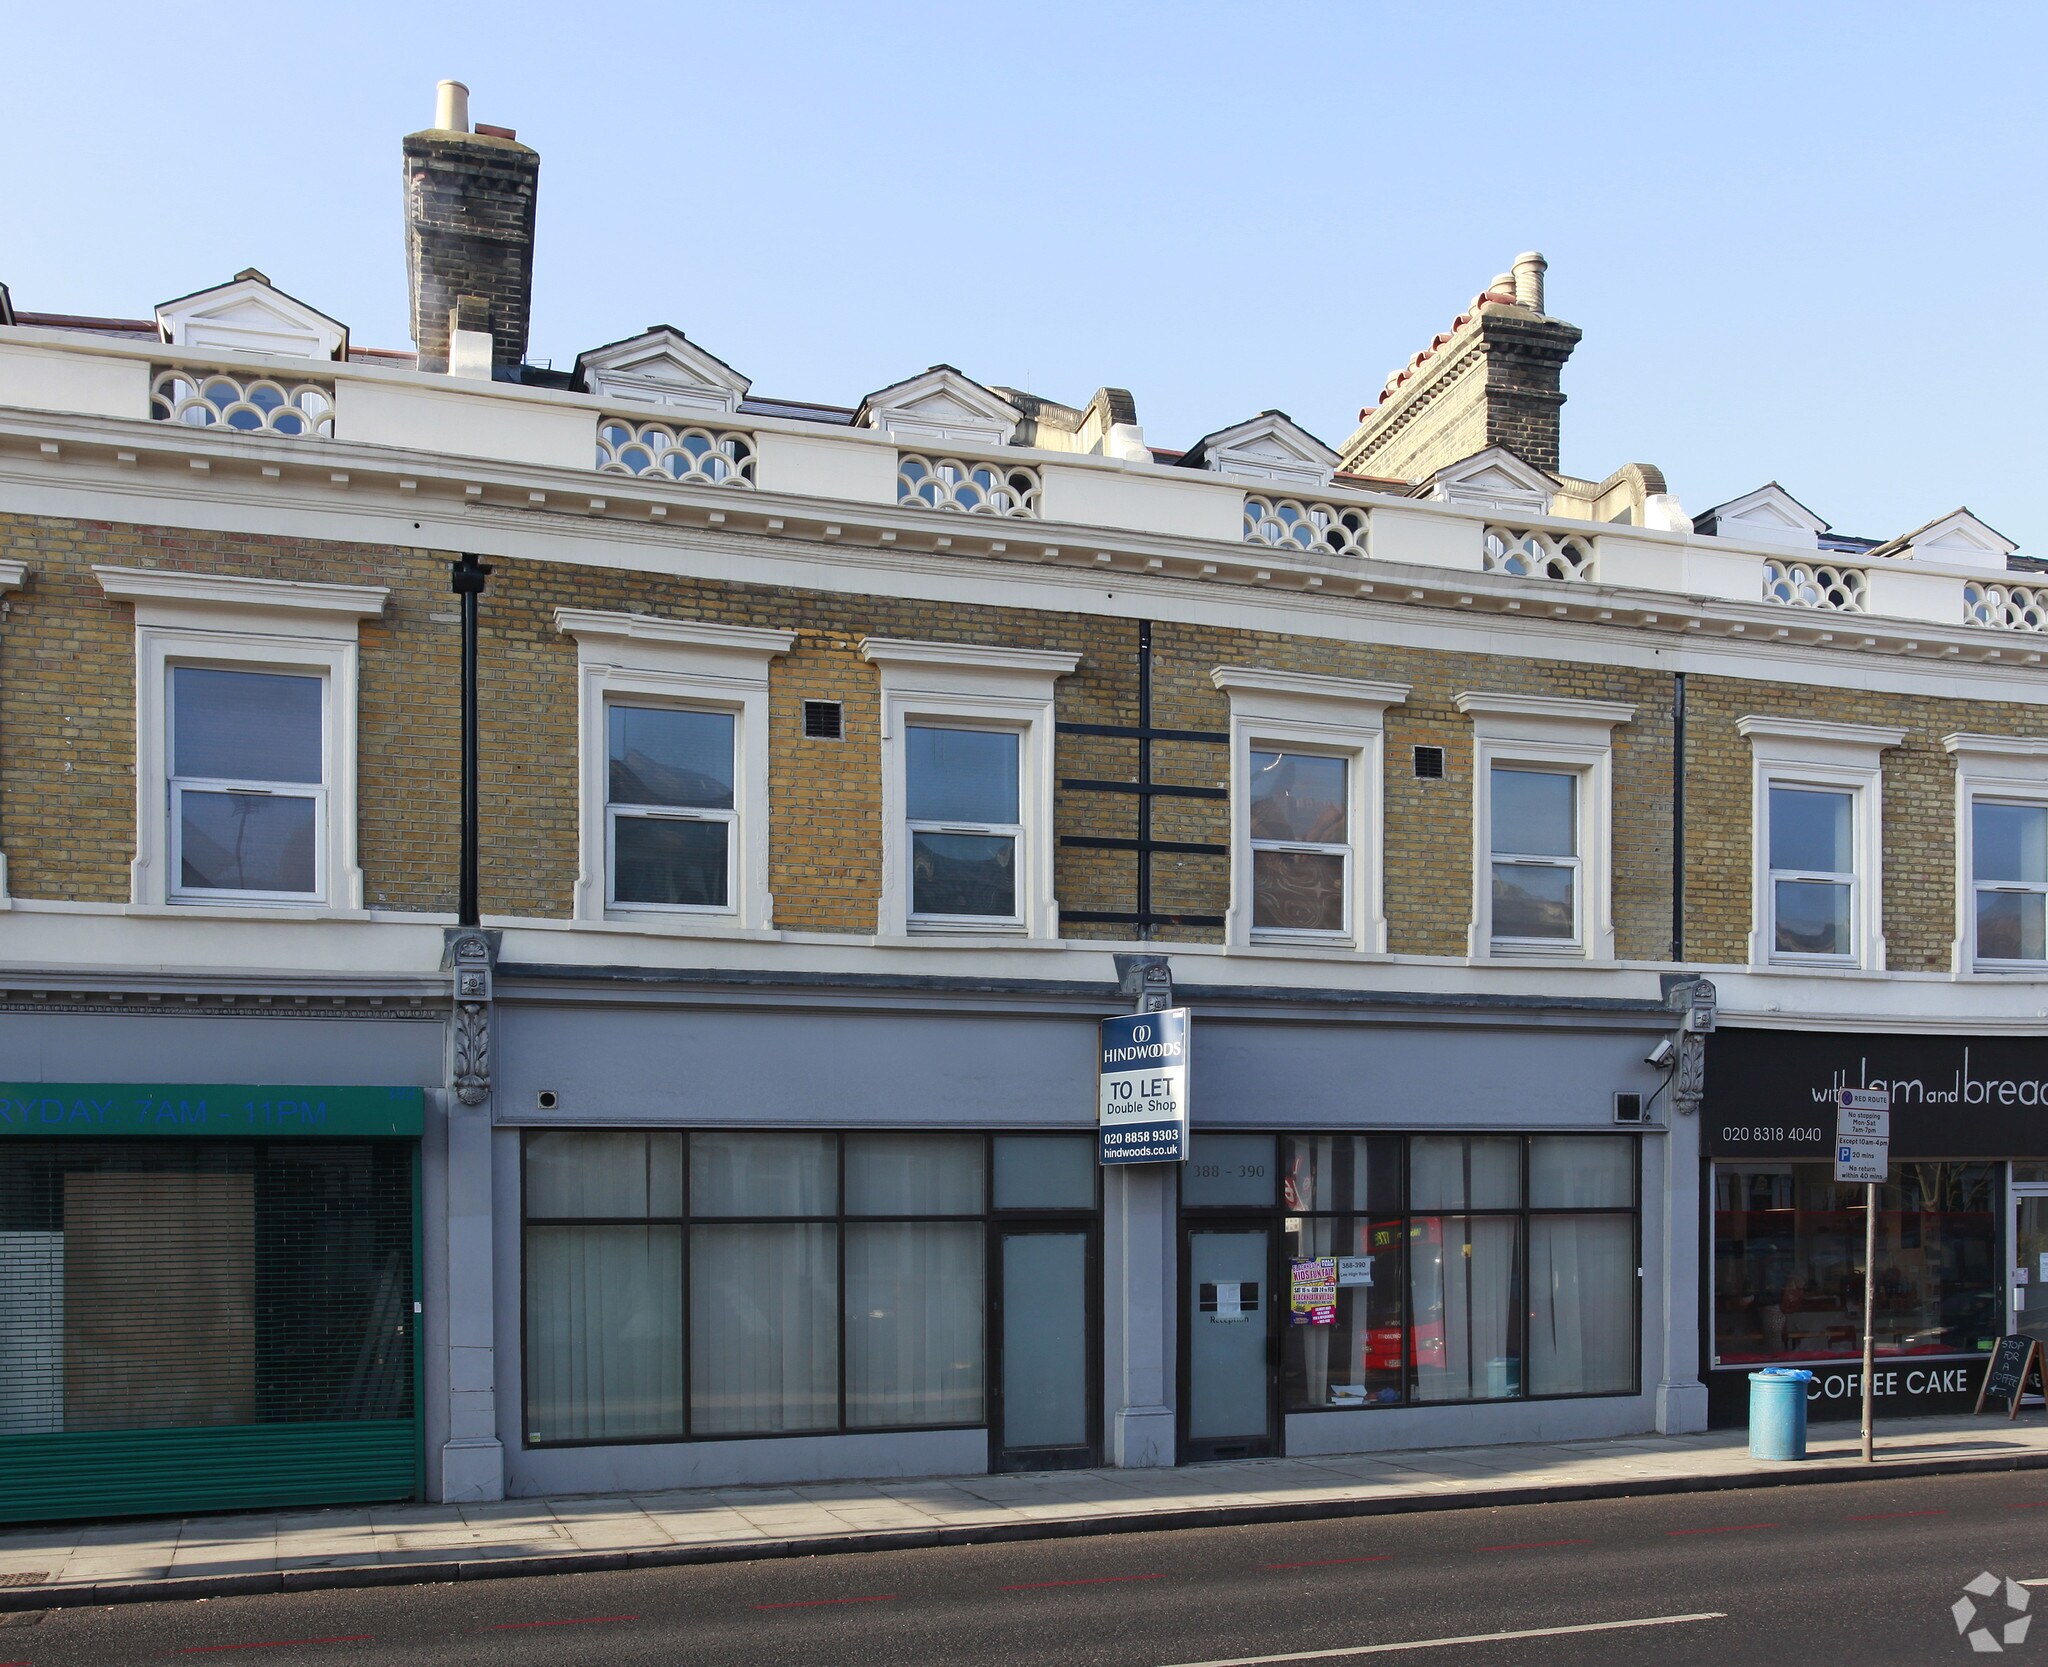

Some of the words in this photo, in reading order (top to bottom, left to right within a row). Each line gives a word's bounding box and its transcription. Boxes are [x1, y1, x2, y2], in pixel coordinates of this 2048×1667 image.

[1104, 1041, 1181, 1063] HINDWOODS
[1110, 1080, 1133, 1100] TO
[1141, 1078, 1174, 1098] LET
[1926, 1069, 1959, 1104] and
[1107, 1101, 1143, 1115] Double
[1148, 1099, 1177, 1113] Shop
[1868, 1096, 1887, 1104] ROUTE
[135, 1099, 207, 1125] 7AM
[245, 1100, 326, 1126] 11PM
[1857, 1112, 1881, 1120] stopping
[1104, 1133, 1123, 1145] 020
[1124, 1131, 1150, 1143] 8858
[1152, 1129, 1179, 1142] 9303
[1722, 1126, 1750, 1142] 020
[1753, 1126, 1784, 1142] 8318
[1788, 1127, 1822, 1142] 4040
[1839, 1137, 1858, 1145] Except
[1858, 1138, 1888, 1147] 10am-4pm
[1104, 1144, 1178, 1158] hindwoods.co.uk
[1193, 1165, 1220, 1178] 388
[1239, 1165, 1265, 1178] 390
[1342, 1261, 1366, 1269] 388-390
[1293, 1270, 1309, 1281] KIDS
[1310, 1269, 1321, 1279] FUN
[1322, 1267, 1334, 1277] FAIR
[2001, 1340, 2025, 1350] STOP
[2003, 1350, 2020, 1362] FOR
[2001, 1362, 2010, 1371] A
[1906, 1368, 1968, 1395] CAKE
[1992, 1371, 2020, 1388] COFFEE
